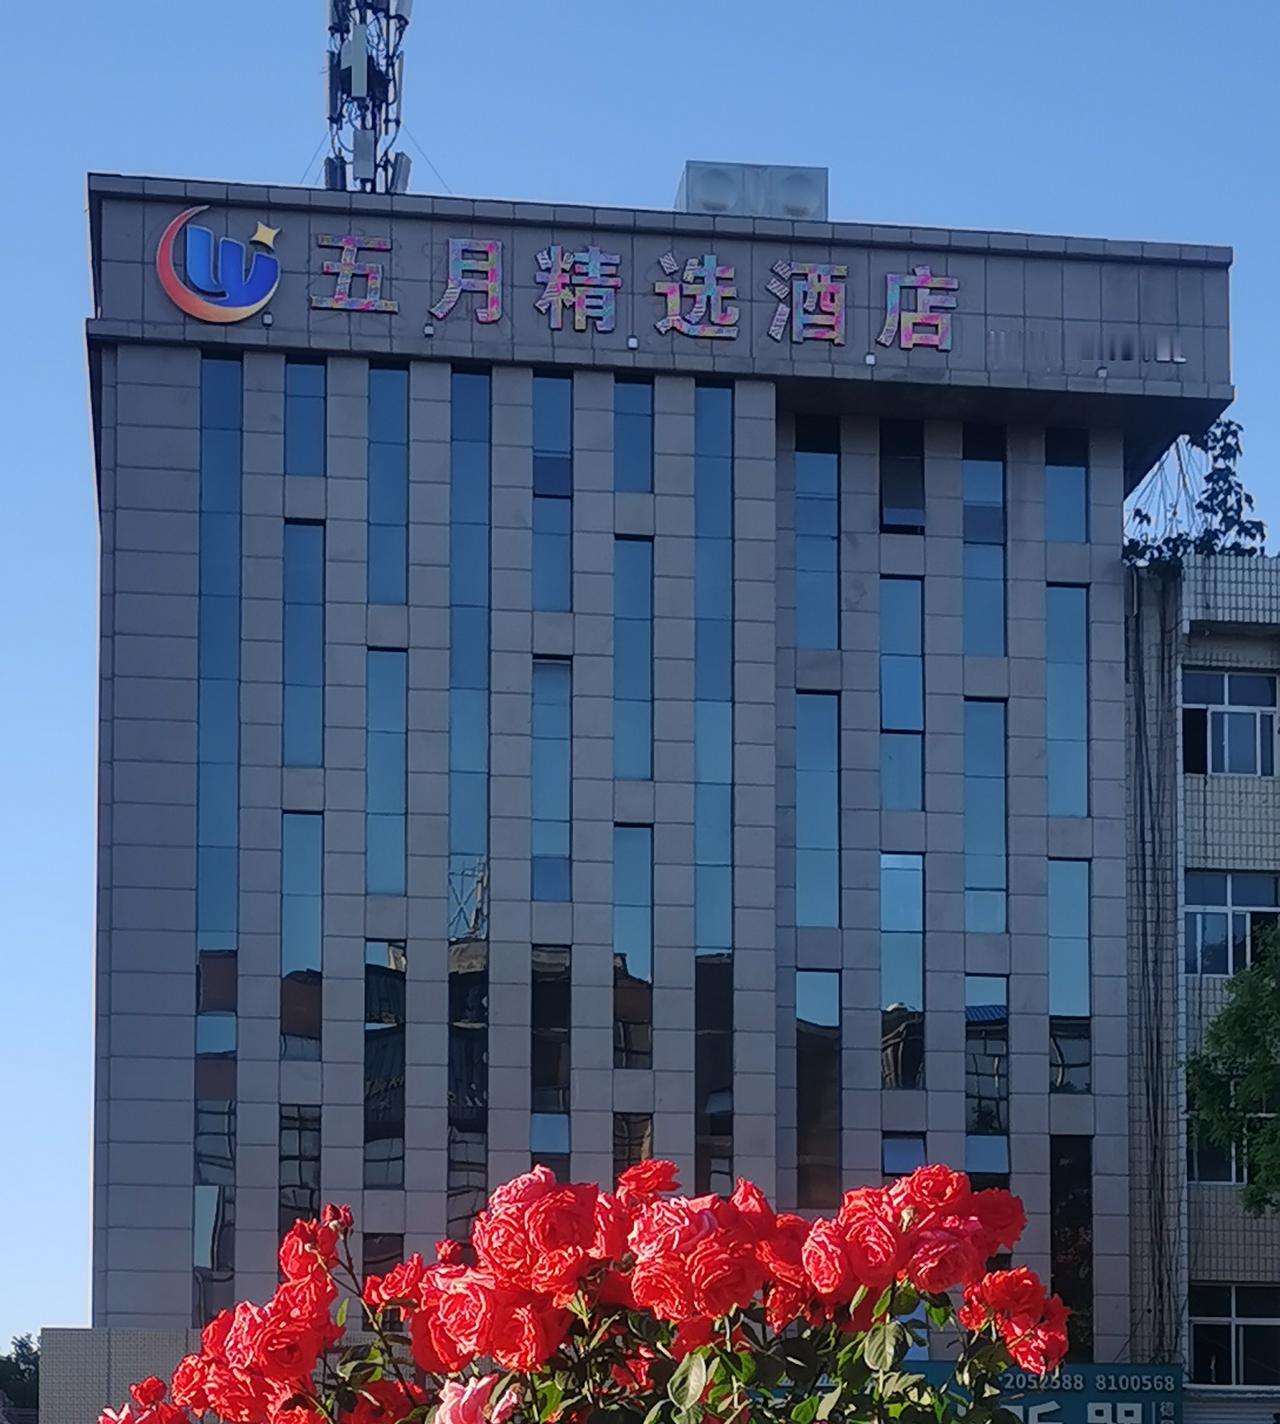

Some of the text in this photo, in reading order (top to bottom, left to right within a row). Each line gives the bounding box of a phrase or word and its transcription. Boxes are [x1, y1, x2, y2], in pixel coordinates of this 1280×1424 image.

[310, 232, 959, 352] 五月精选酒店
[1096, 1374, 1175, 1392] 8100568
